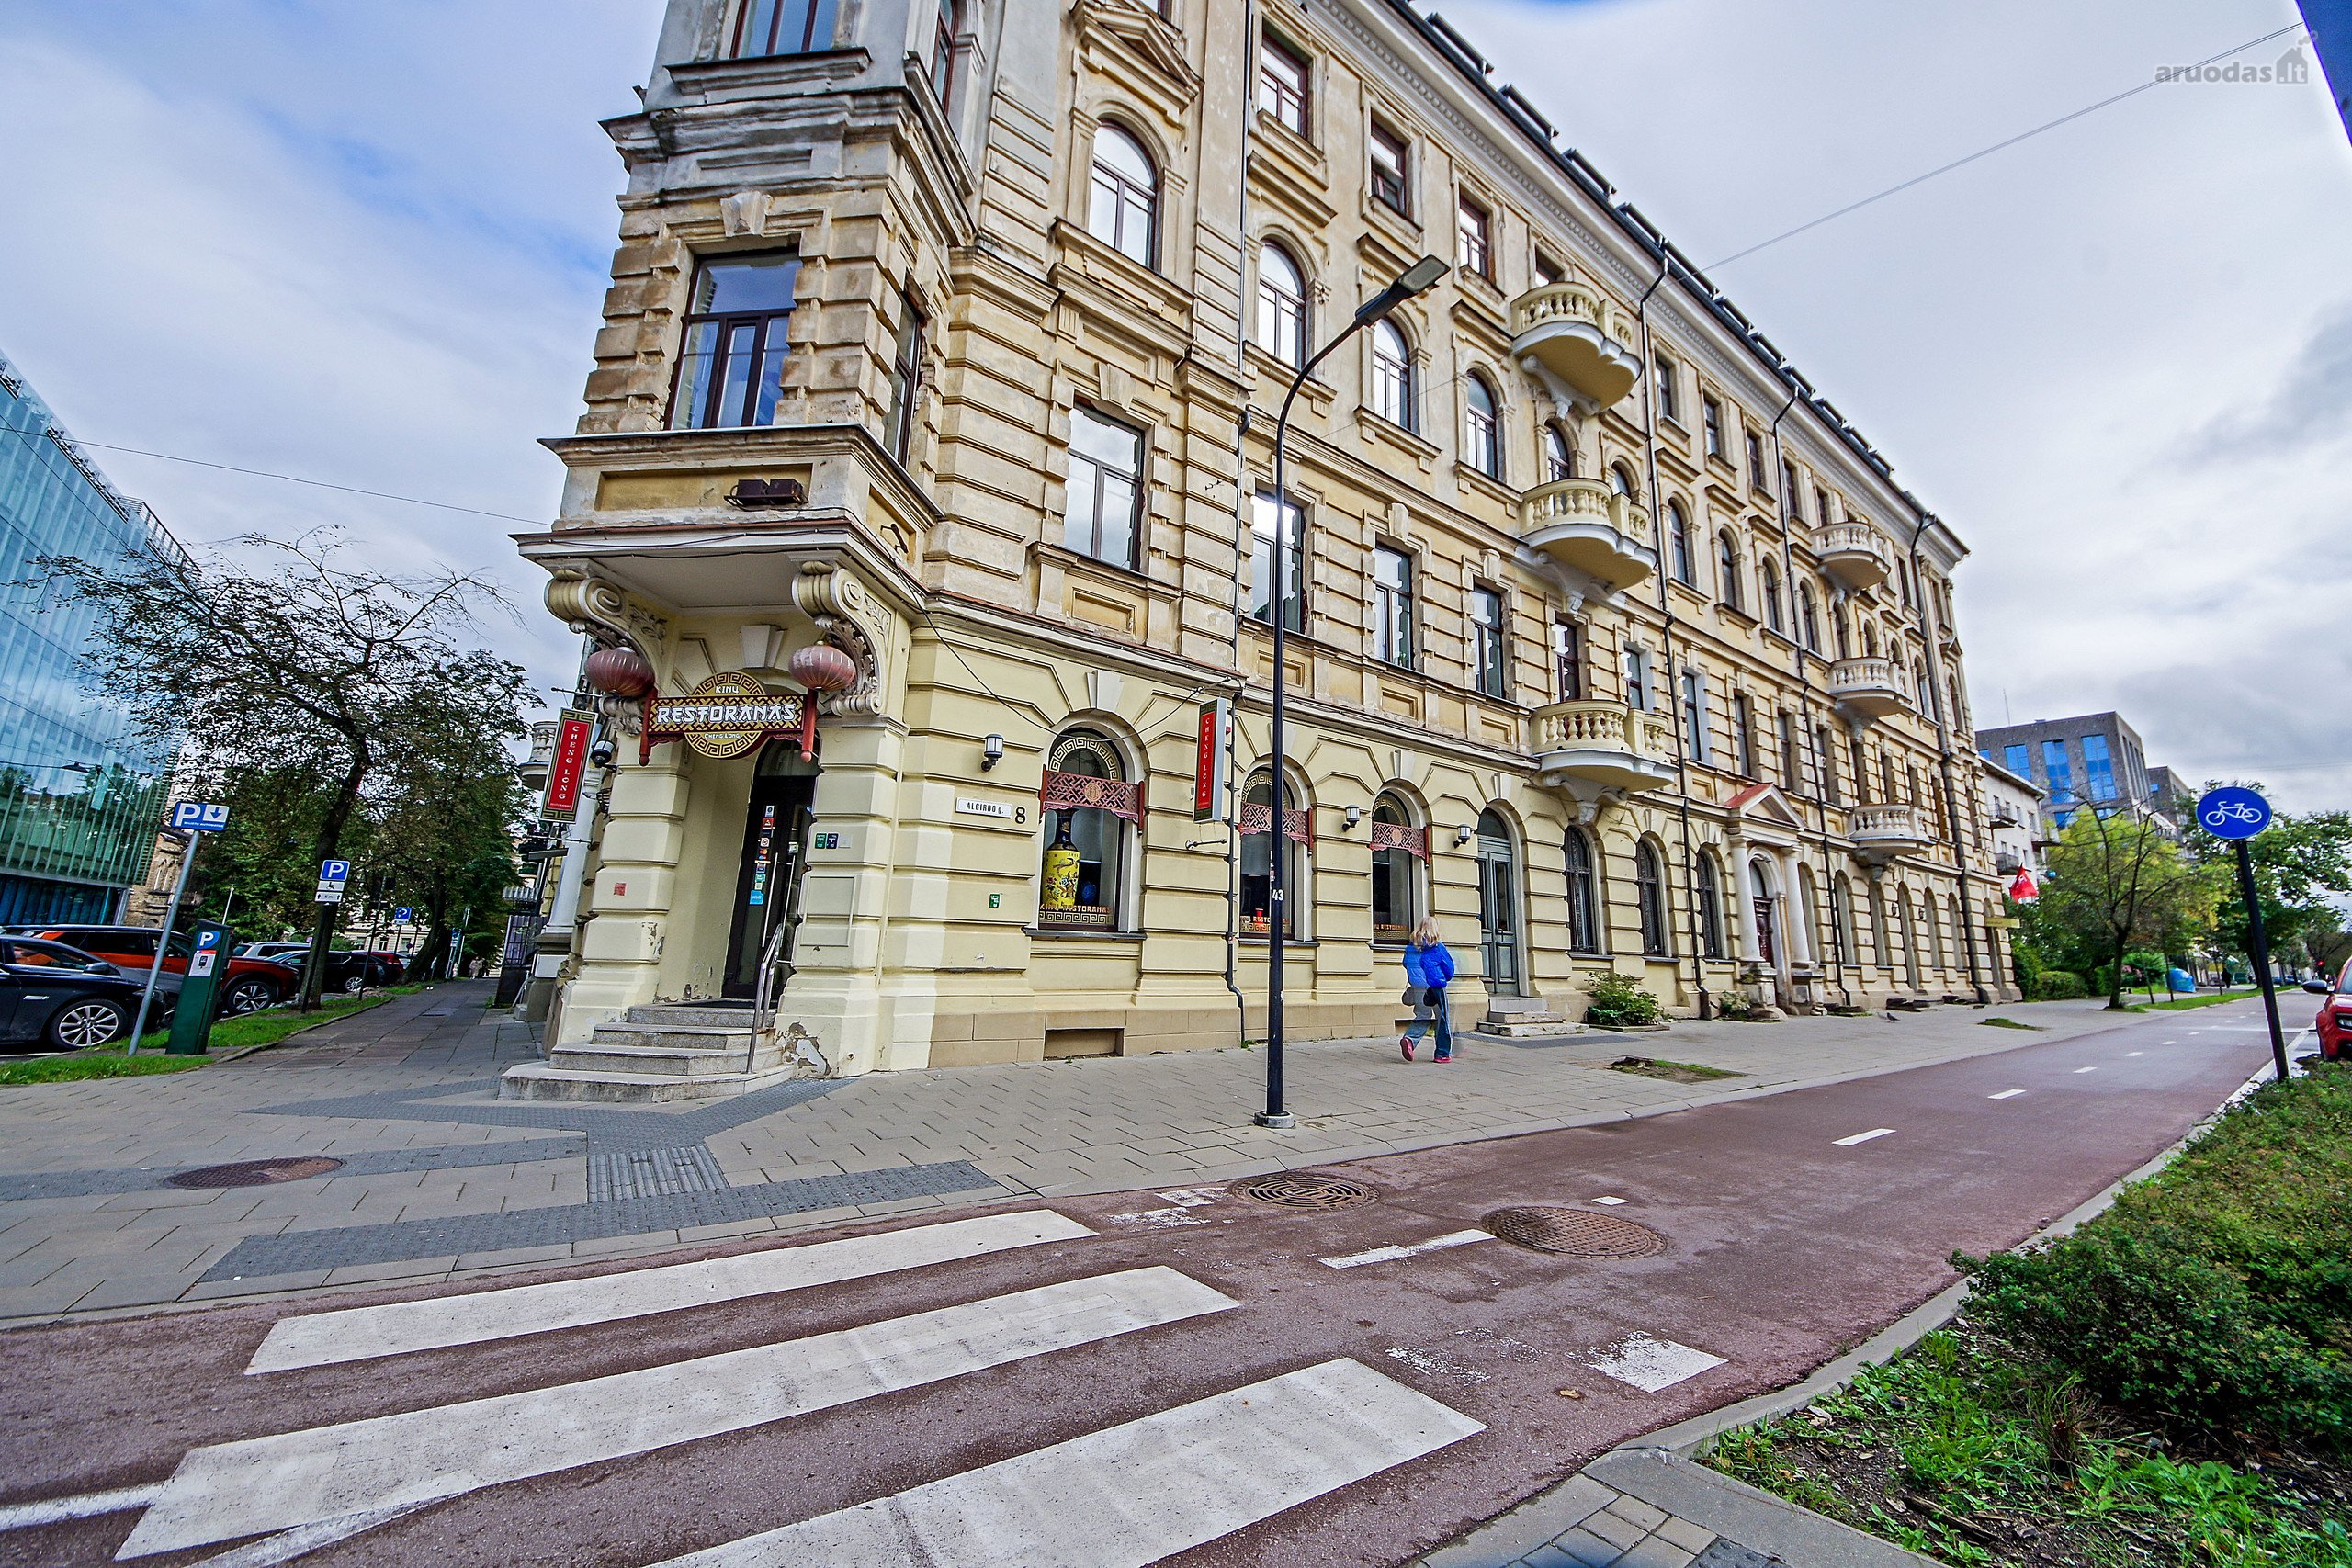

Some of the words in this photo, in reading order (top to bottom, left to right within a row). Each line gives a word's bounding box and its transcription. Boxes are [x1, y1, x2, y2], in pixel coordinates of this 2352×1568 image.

[656, 703, 797, 724] RESTORANAS
[565, 726, 581, 764] CHENG
[559, 769, 571, 800] LONG
[175, 803, 201, 827] P
[966, 802, 996, 813] ALGIRDO
[1014, 807, 1026, 824] 8
[327, 863, 345, 878] P
[1272, 889, 1284, 900] 43
[199, 931, 214, 946] P
